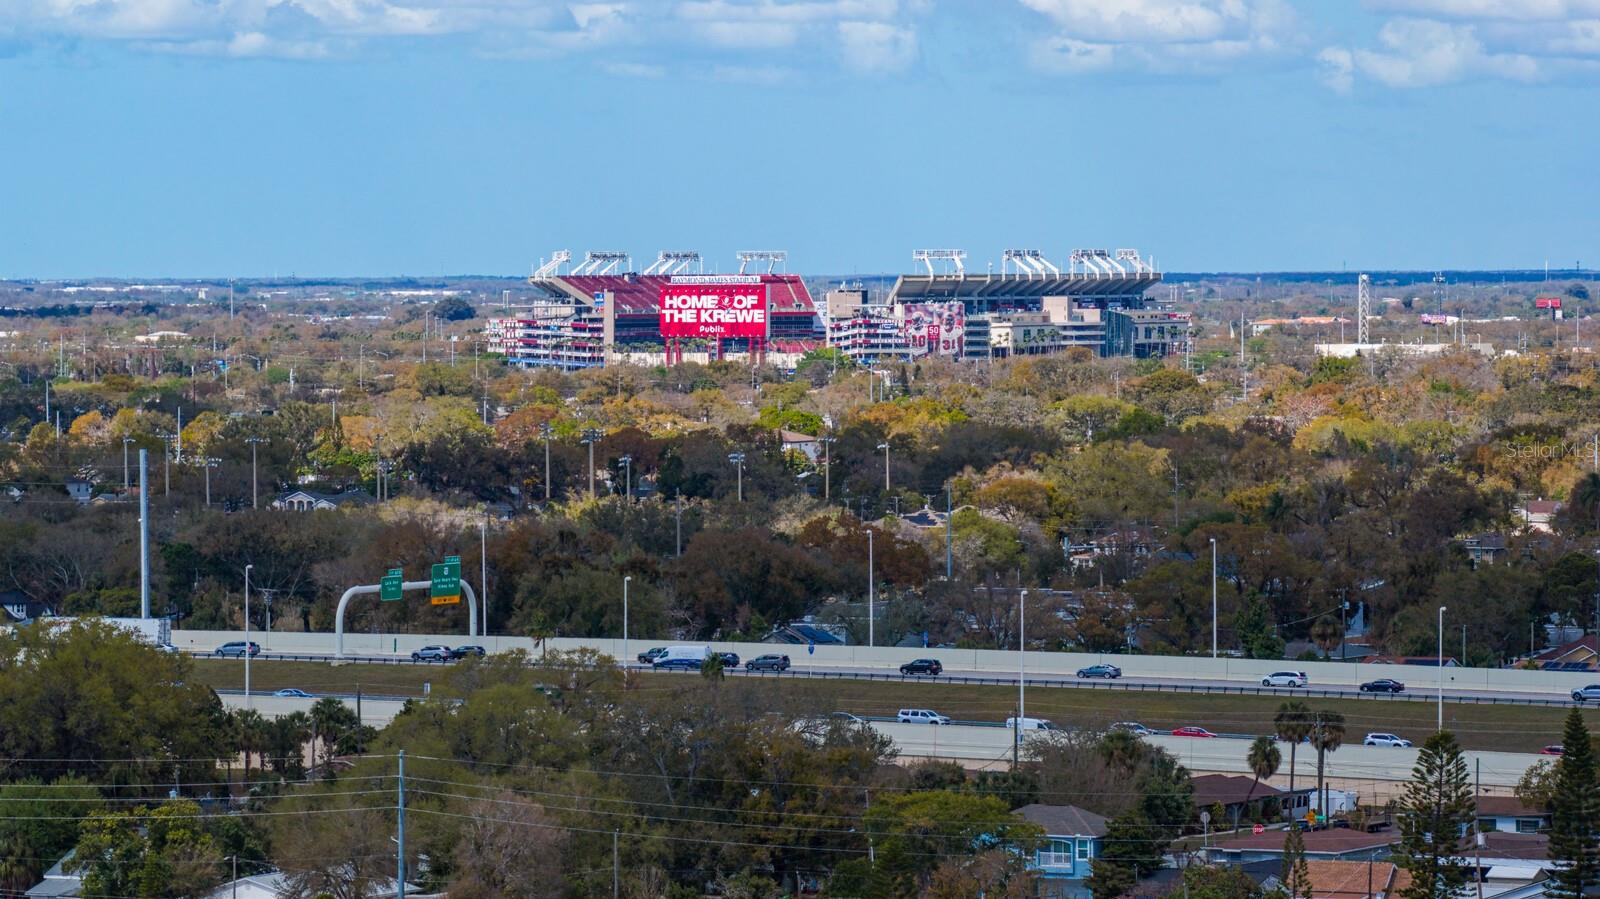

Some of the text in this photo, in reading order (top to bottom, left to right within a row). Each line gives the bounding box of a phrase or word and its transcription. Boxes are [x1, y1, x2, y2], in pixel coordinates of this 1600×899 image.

[665, 295, 758, 308] HOME OF
[662, 309, 764, 322] THE KREWE
[700, 325, 724, 333] Publix
